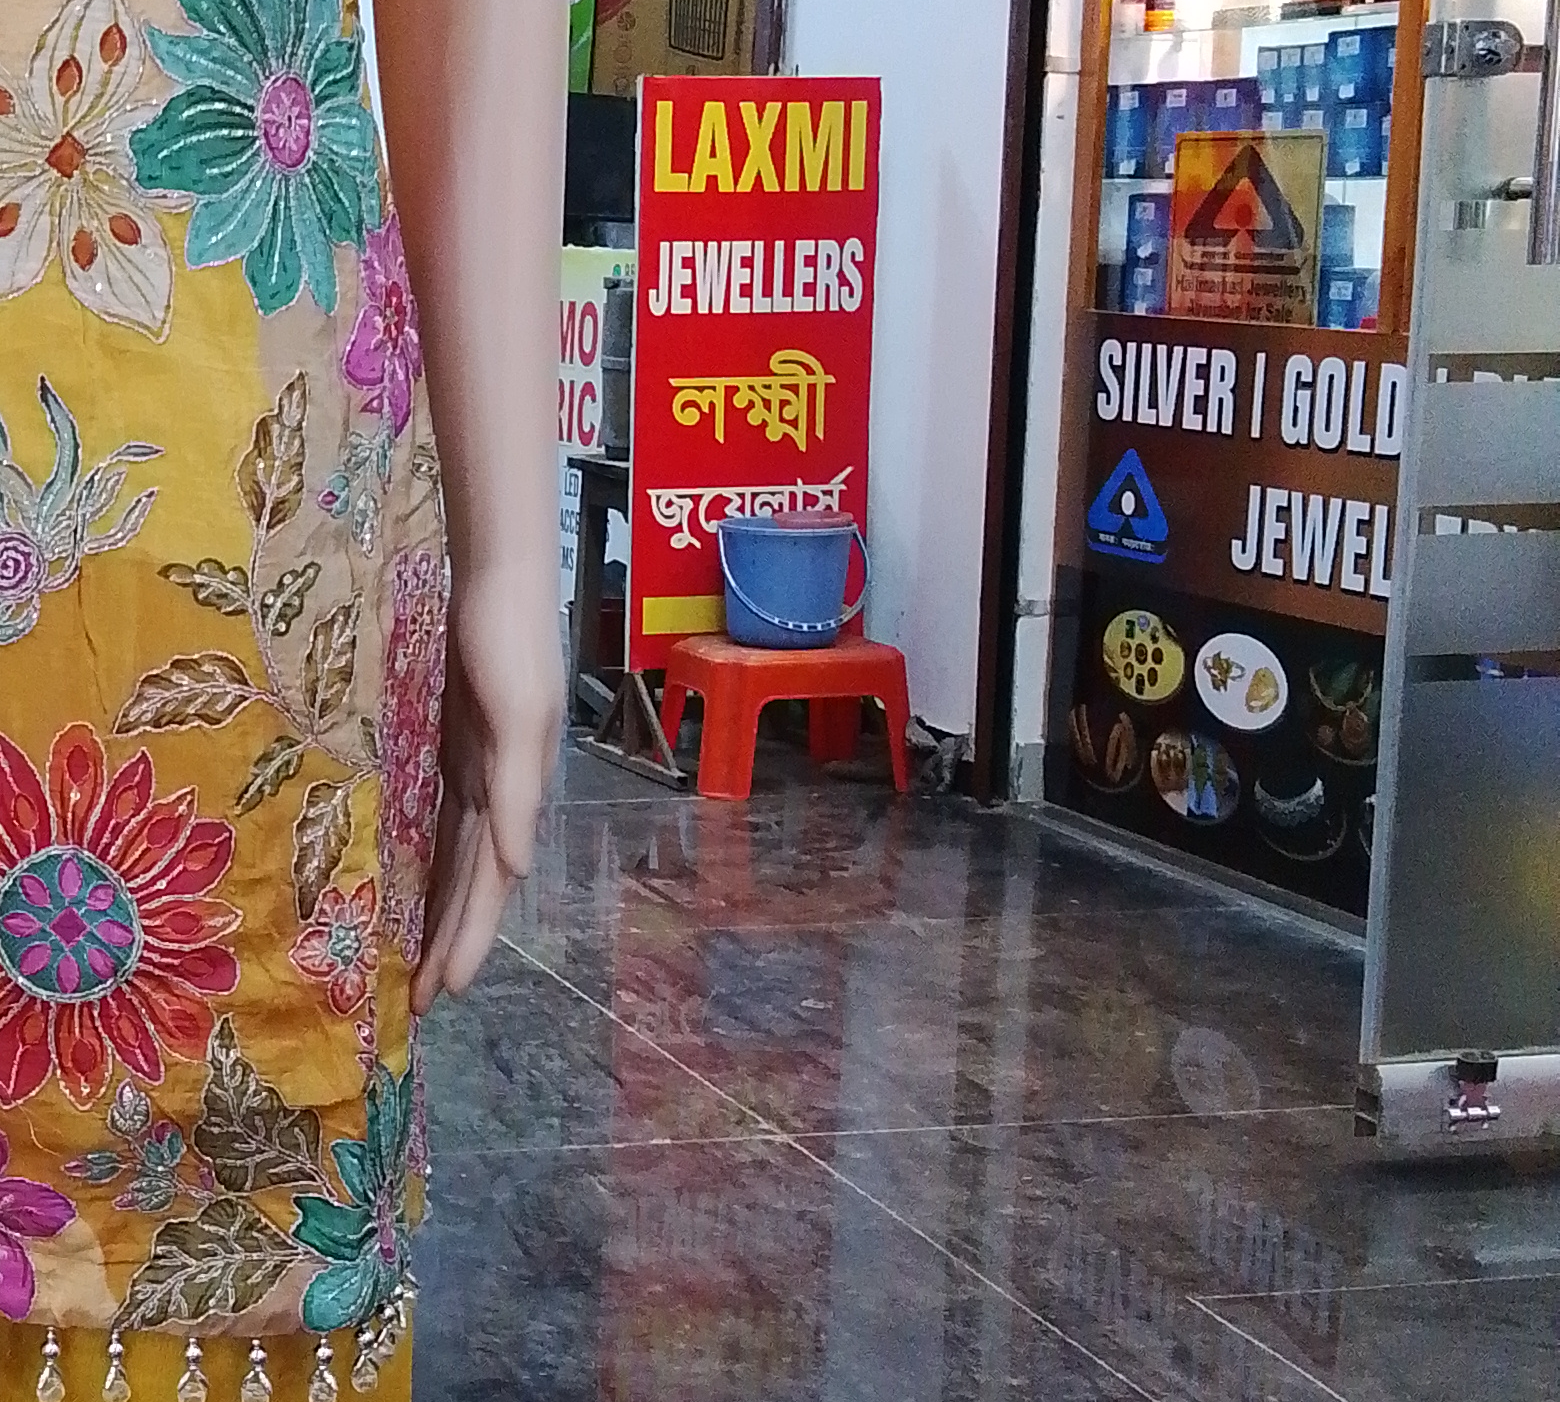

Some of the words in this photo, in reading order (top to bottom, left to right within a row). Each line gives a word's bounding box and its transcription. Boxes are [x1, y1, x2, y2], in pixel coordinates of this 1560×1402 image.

[653, 100, 869, 193] LAXMI
[648, 238, 865, 316] JEWELLERS
[1097, 339, 1237, 437] SILVER
[1280, 354, 1408, 457] GOLD
